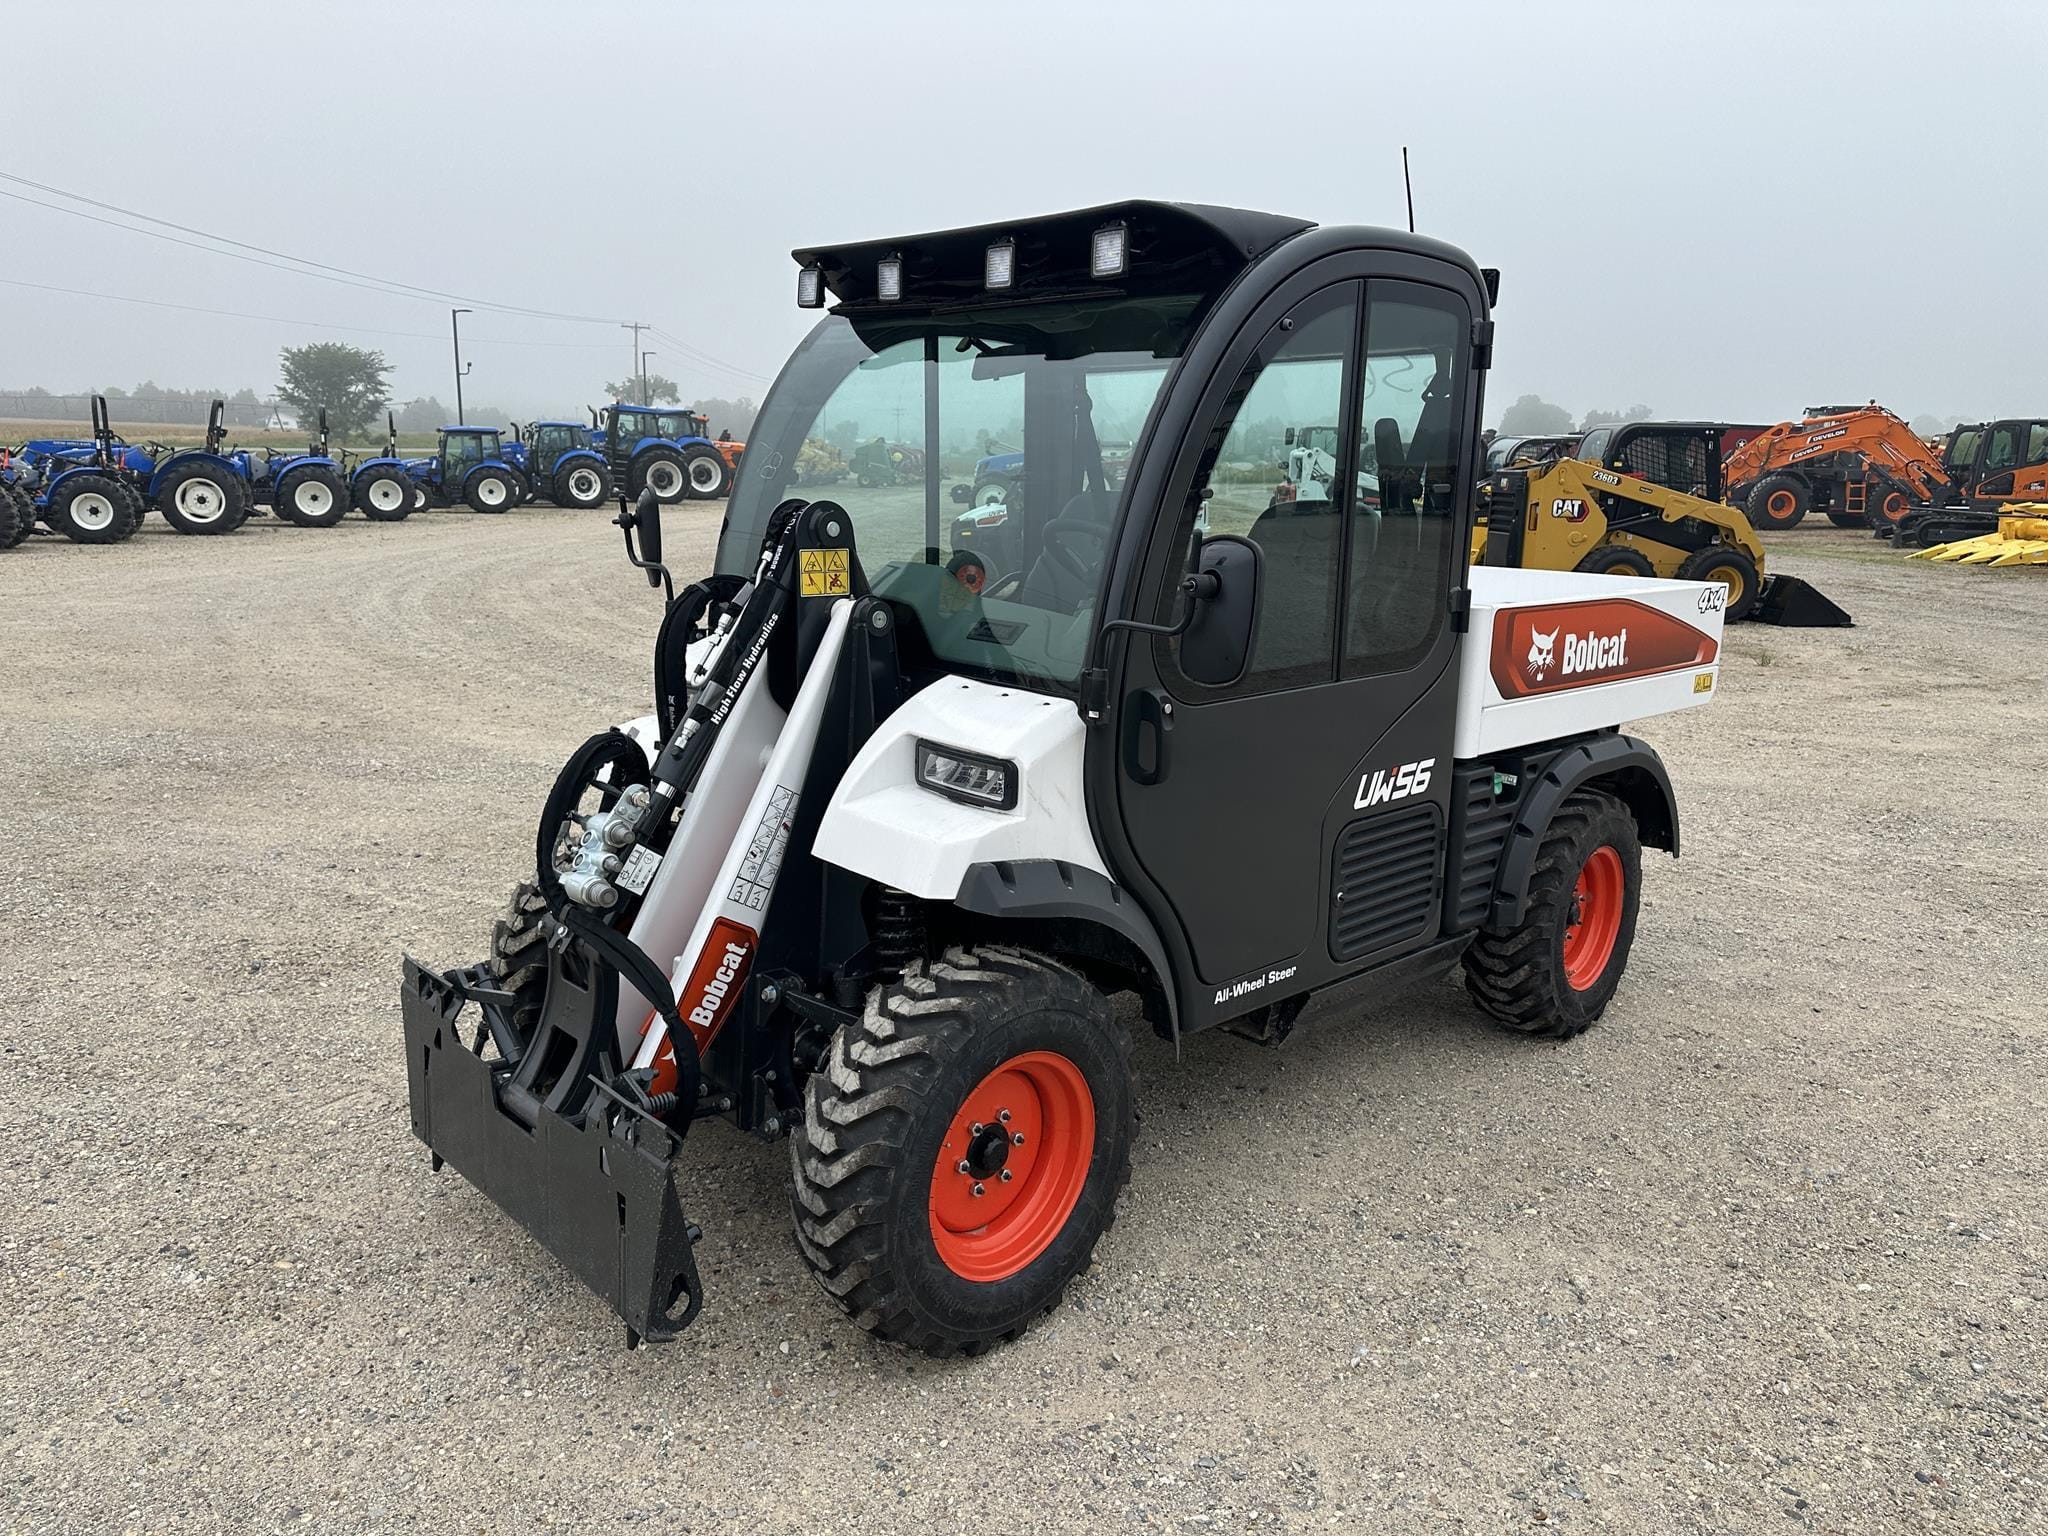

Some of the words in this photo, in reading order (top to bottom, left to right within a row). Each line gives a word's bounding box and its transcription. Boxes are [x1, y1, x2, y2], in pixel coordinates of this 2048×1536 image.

[1794, 445, 1823, 458] DEVELON
[1812, 429, 1846, 442] DEVELON
[1592, 470, 1619, 485] 236D3
[1552, 499, 1583, 518] CAT
[1697, 586, 1727, 614] 4x4
[1562, 628, 1627, 675] Bobcat
[710, 697, 731, 725] High
[726, 669, 747, 698] Flow
[742, 613, 779, 669] Hydraulics
[1354, 757, 1436, 810] UW56
[689, 942, 748, 1028] Bobcat
[1214, 973, 1266, 1005] All-Wheel
[1268, 966, 1297, 984] Steer
